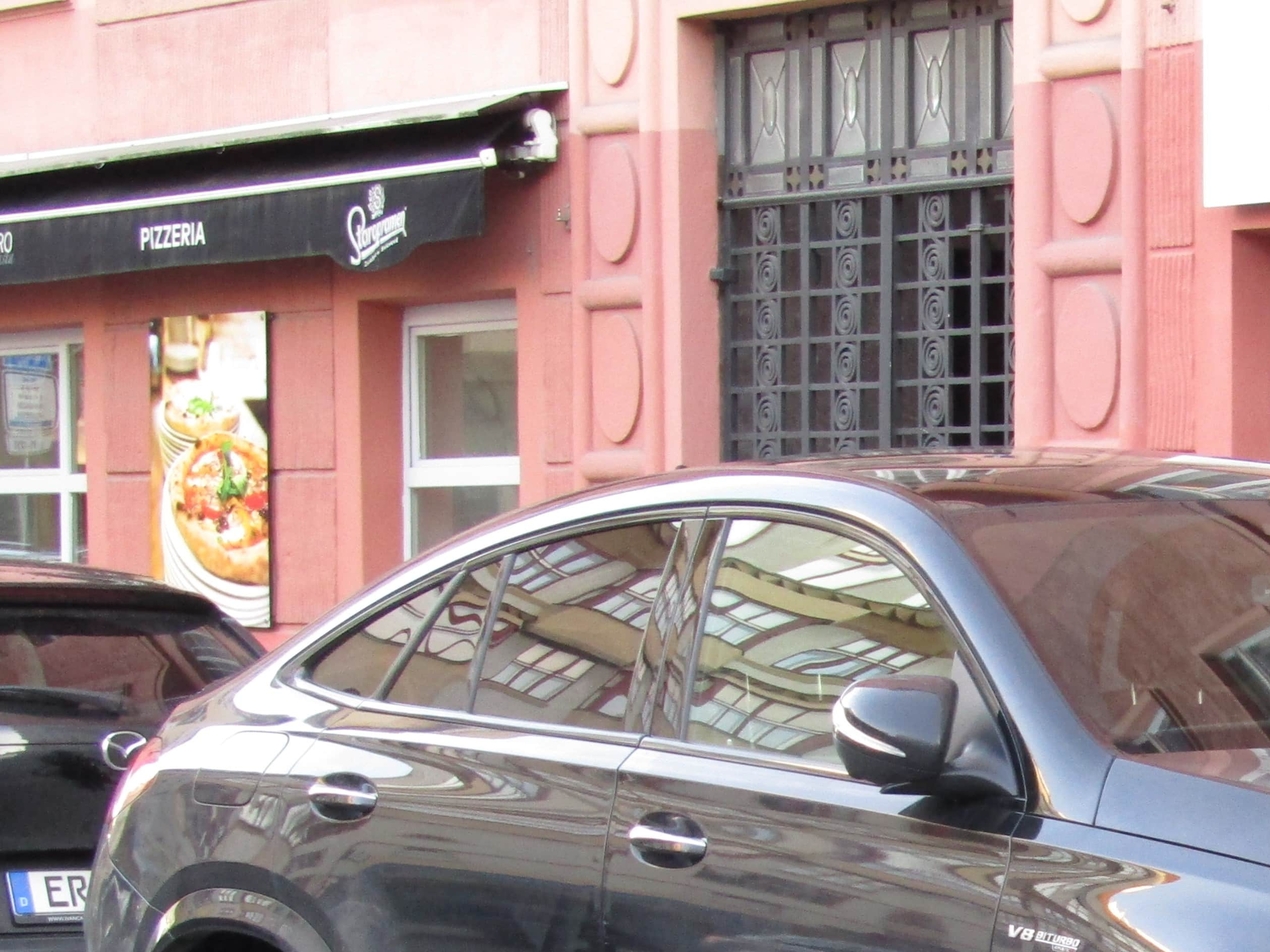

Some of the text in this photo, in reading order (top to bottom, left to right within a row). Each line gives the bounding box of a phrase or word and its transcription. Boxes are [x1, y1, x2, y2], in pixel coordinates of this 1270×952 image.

[140, 221, 206, 250] PIZZERIA
[19, 897, 29, 907] D
[44, 875, 87, 908] ER
[1008, 924, 1081, 948] V8 BITURBO
